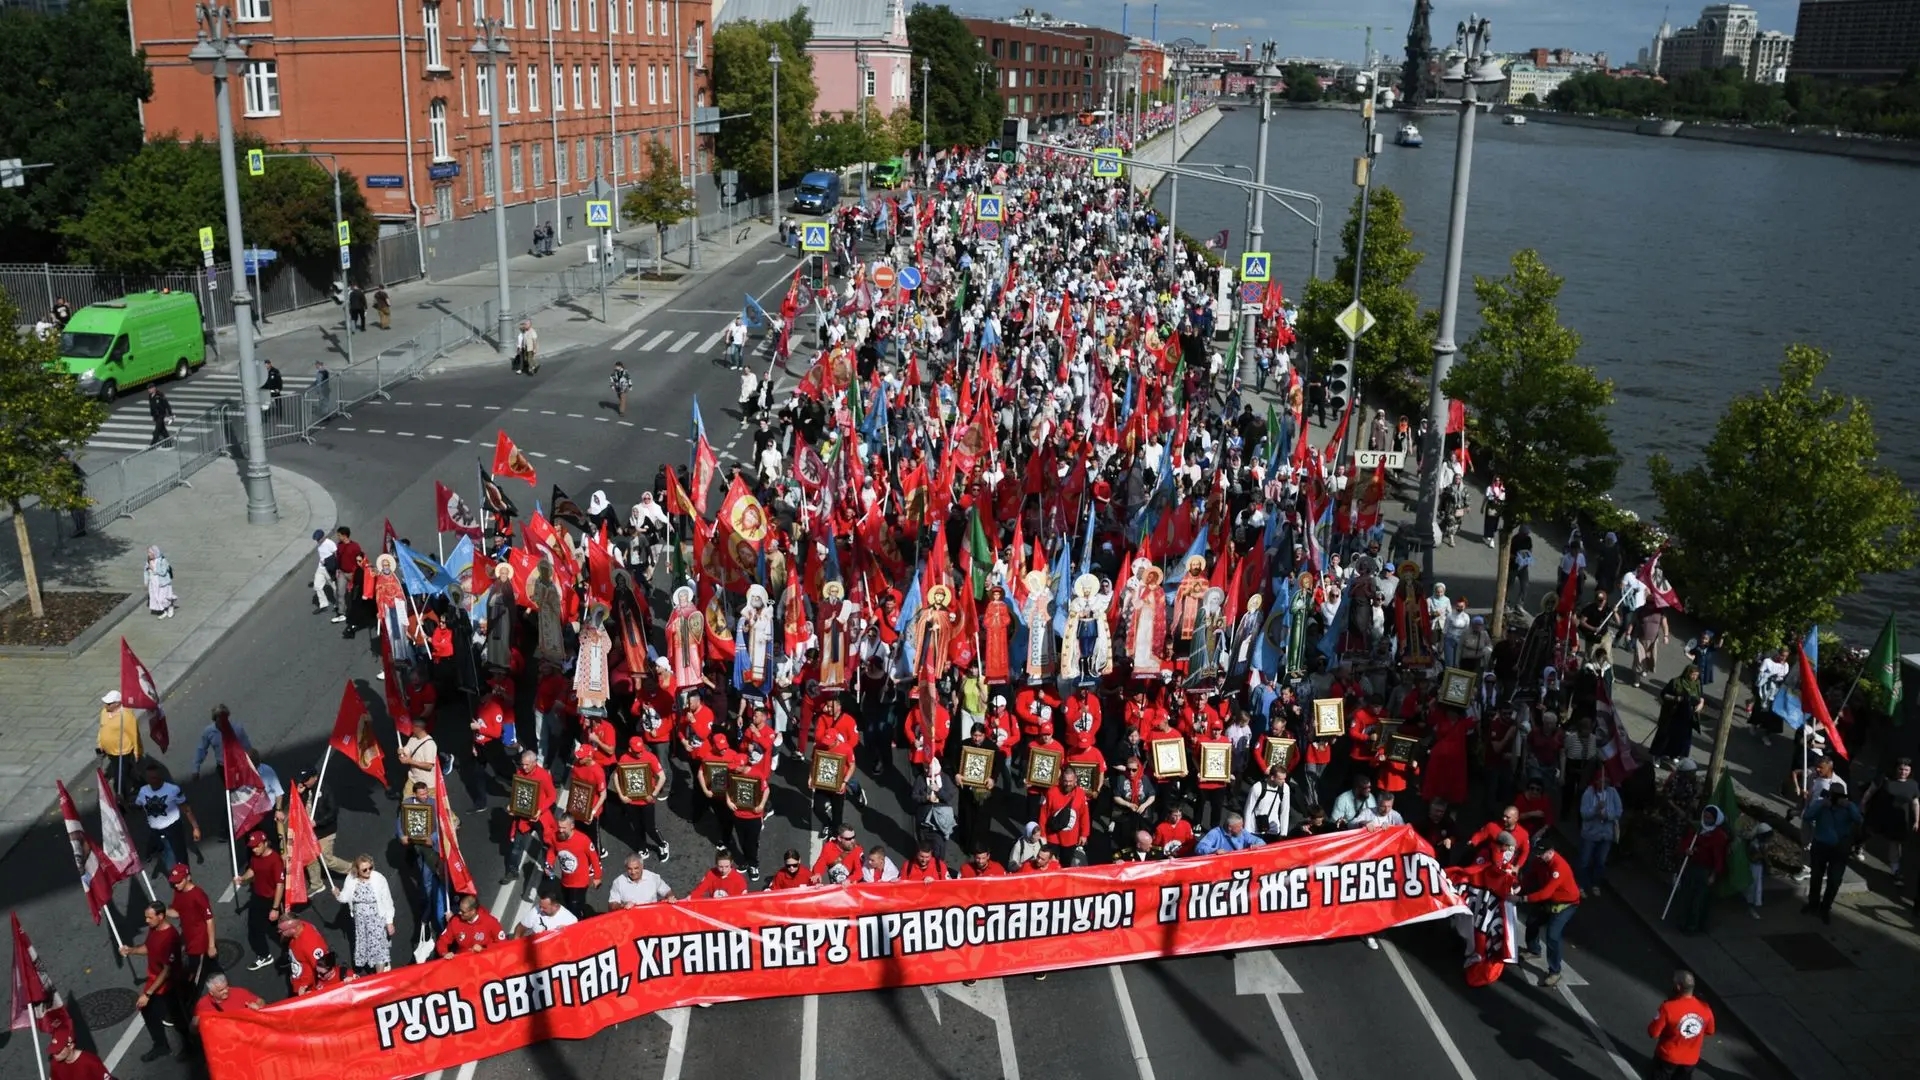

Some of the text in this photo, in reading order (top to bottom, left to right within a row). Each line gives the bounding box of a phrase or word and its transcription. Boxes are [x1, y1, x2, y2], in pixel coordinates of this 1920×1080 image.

[1360, 453, 1397, 465] СТОП
[375, 852, 1446, 1048] РУСЬ СВЯТАЯ, ХРАНИ ВЕРУ ПРАВОСЛАВНУЮ! В НЕЙ ЖЕ ТЕБЕ УТ
